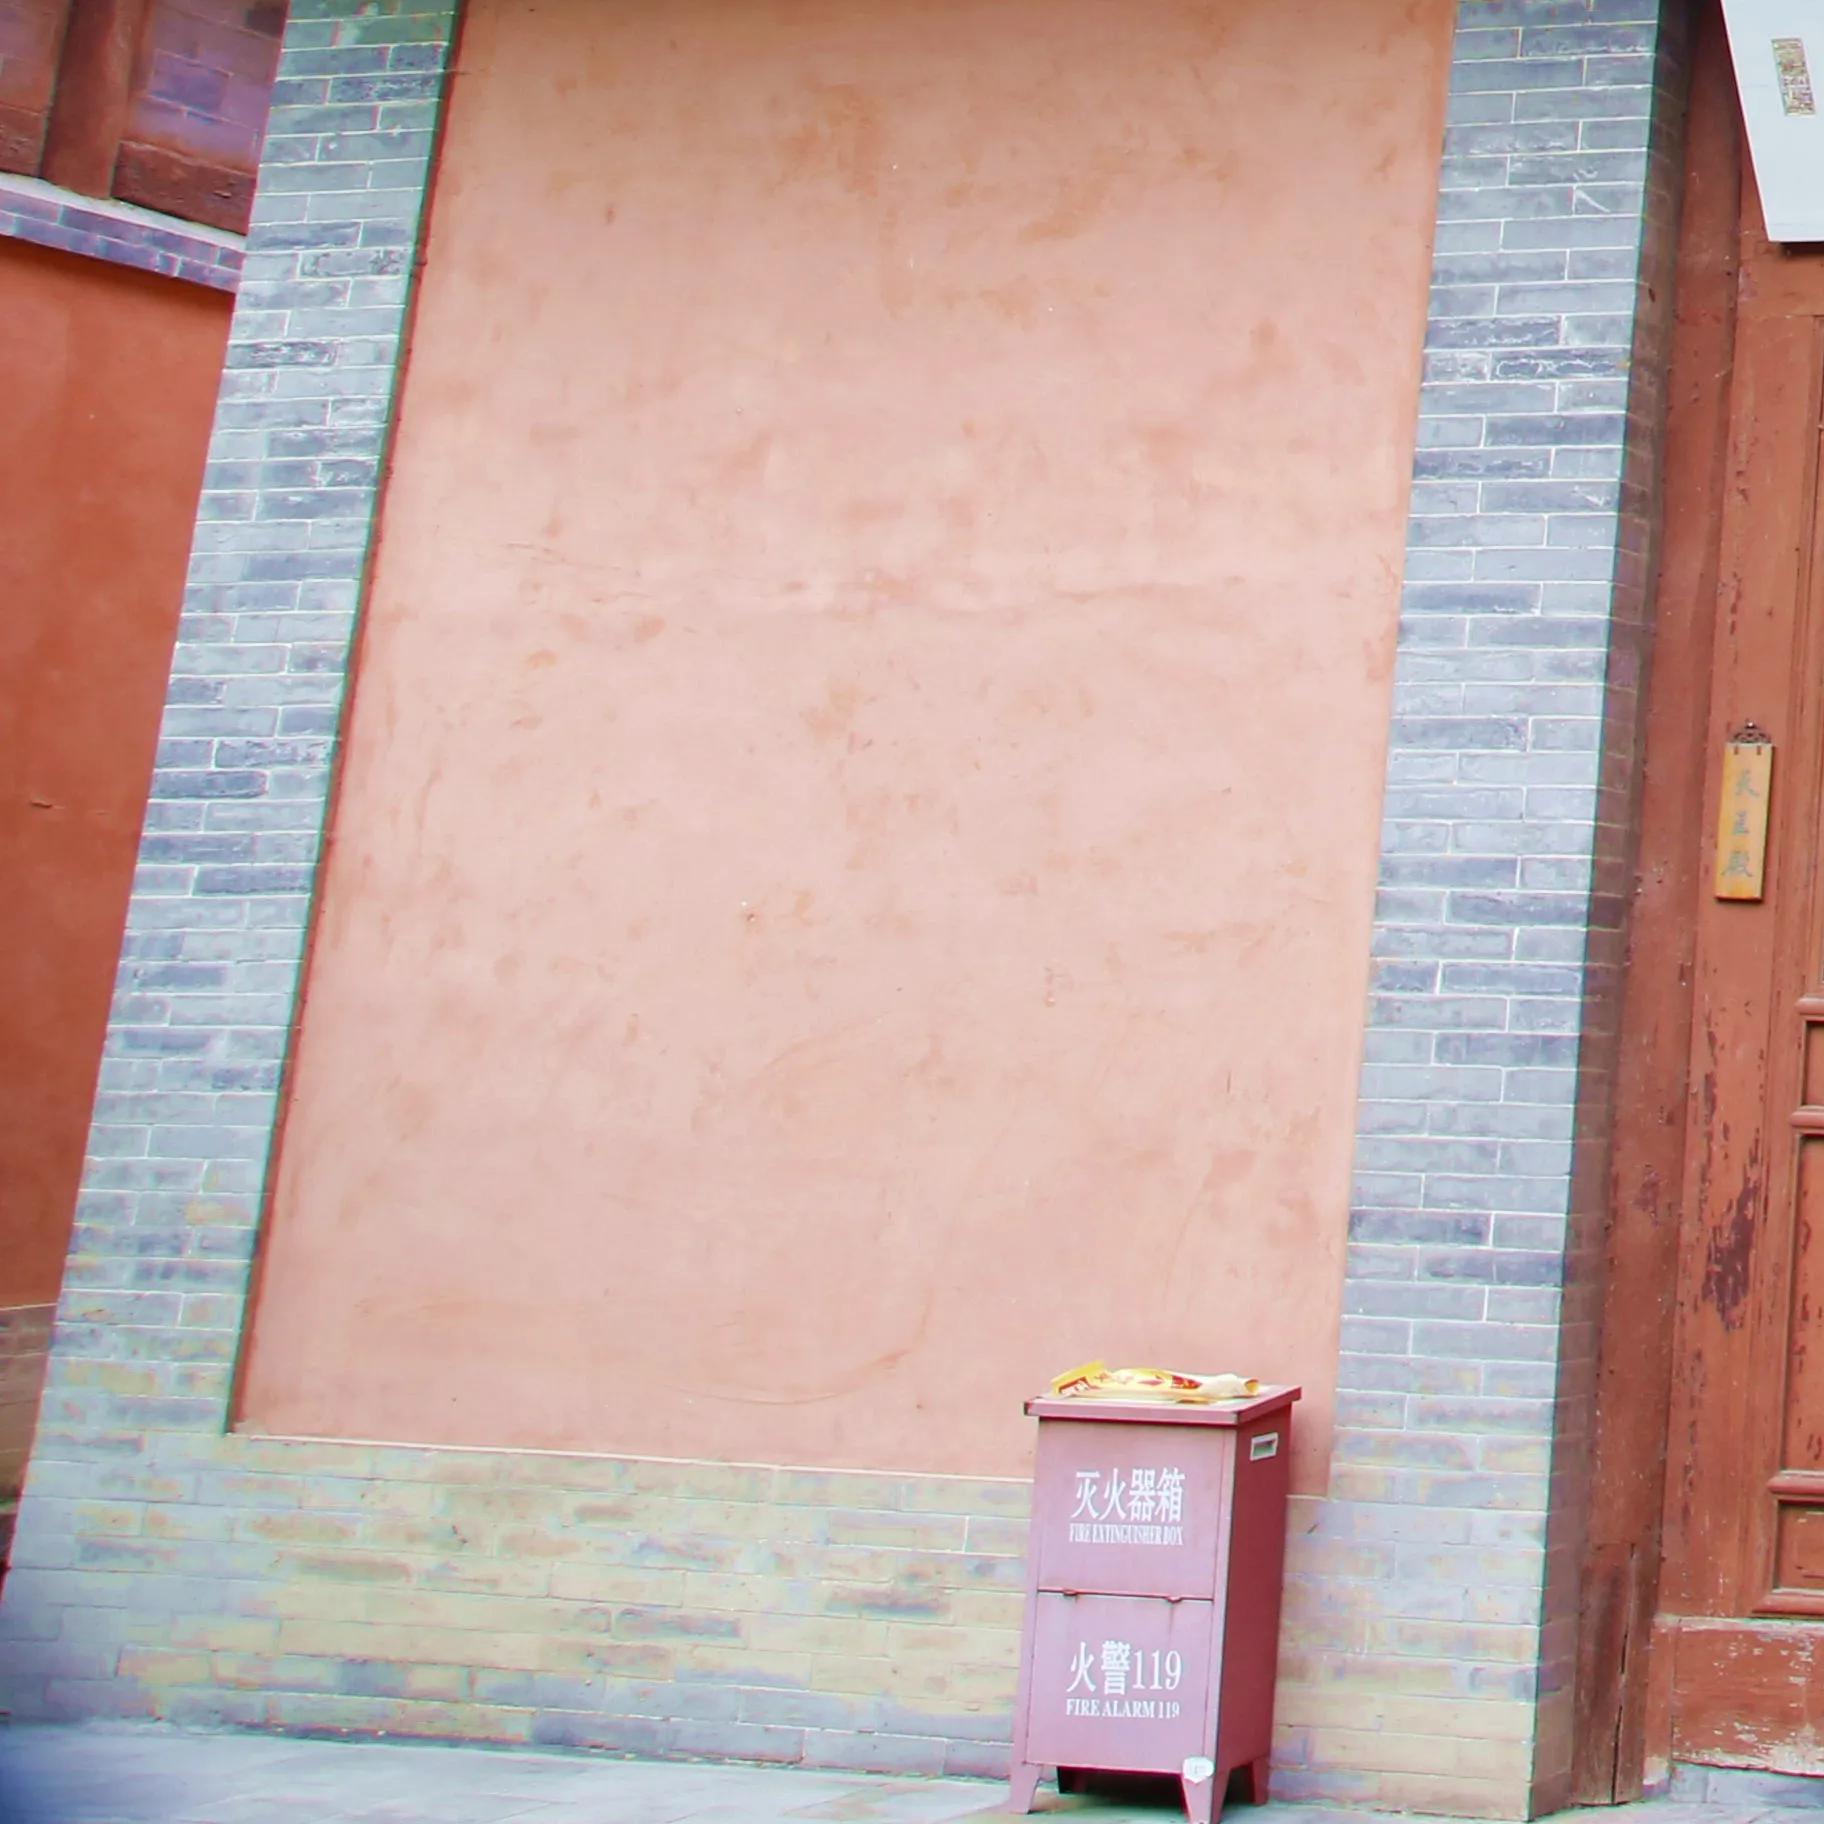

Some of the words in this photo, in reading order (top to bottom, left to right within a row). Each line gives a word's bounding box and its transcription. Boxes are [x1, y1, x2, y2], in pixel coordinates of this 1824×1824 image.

[1071, 1467, 1186, 1522] 灭火器箱
[1069, 1522, 1091, 1543] FIRE
[1092, 1523, 1161, 1545] EXTINGUISHER
[1162, 1525, 1184, 1546] BOX
[1066, 1640, 1182, 1695] 火警119
[1066, 1698, 1100, 1716] FIRE
[1102, 1699, 1156, 1718] ALARM
[1157, 1700, 1181, 1719] 119
